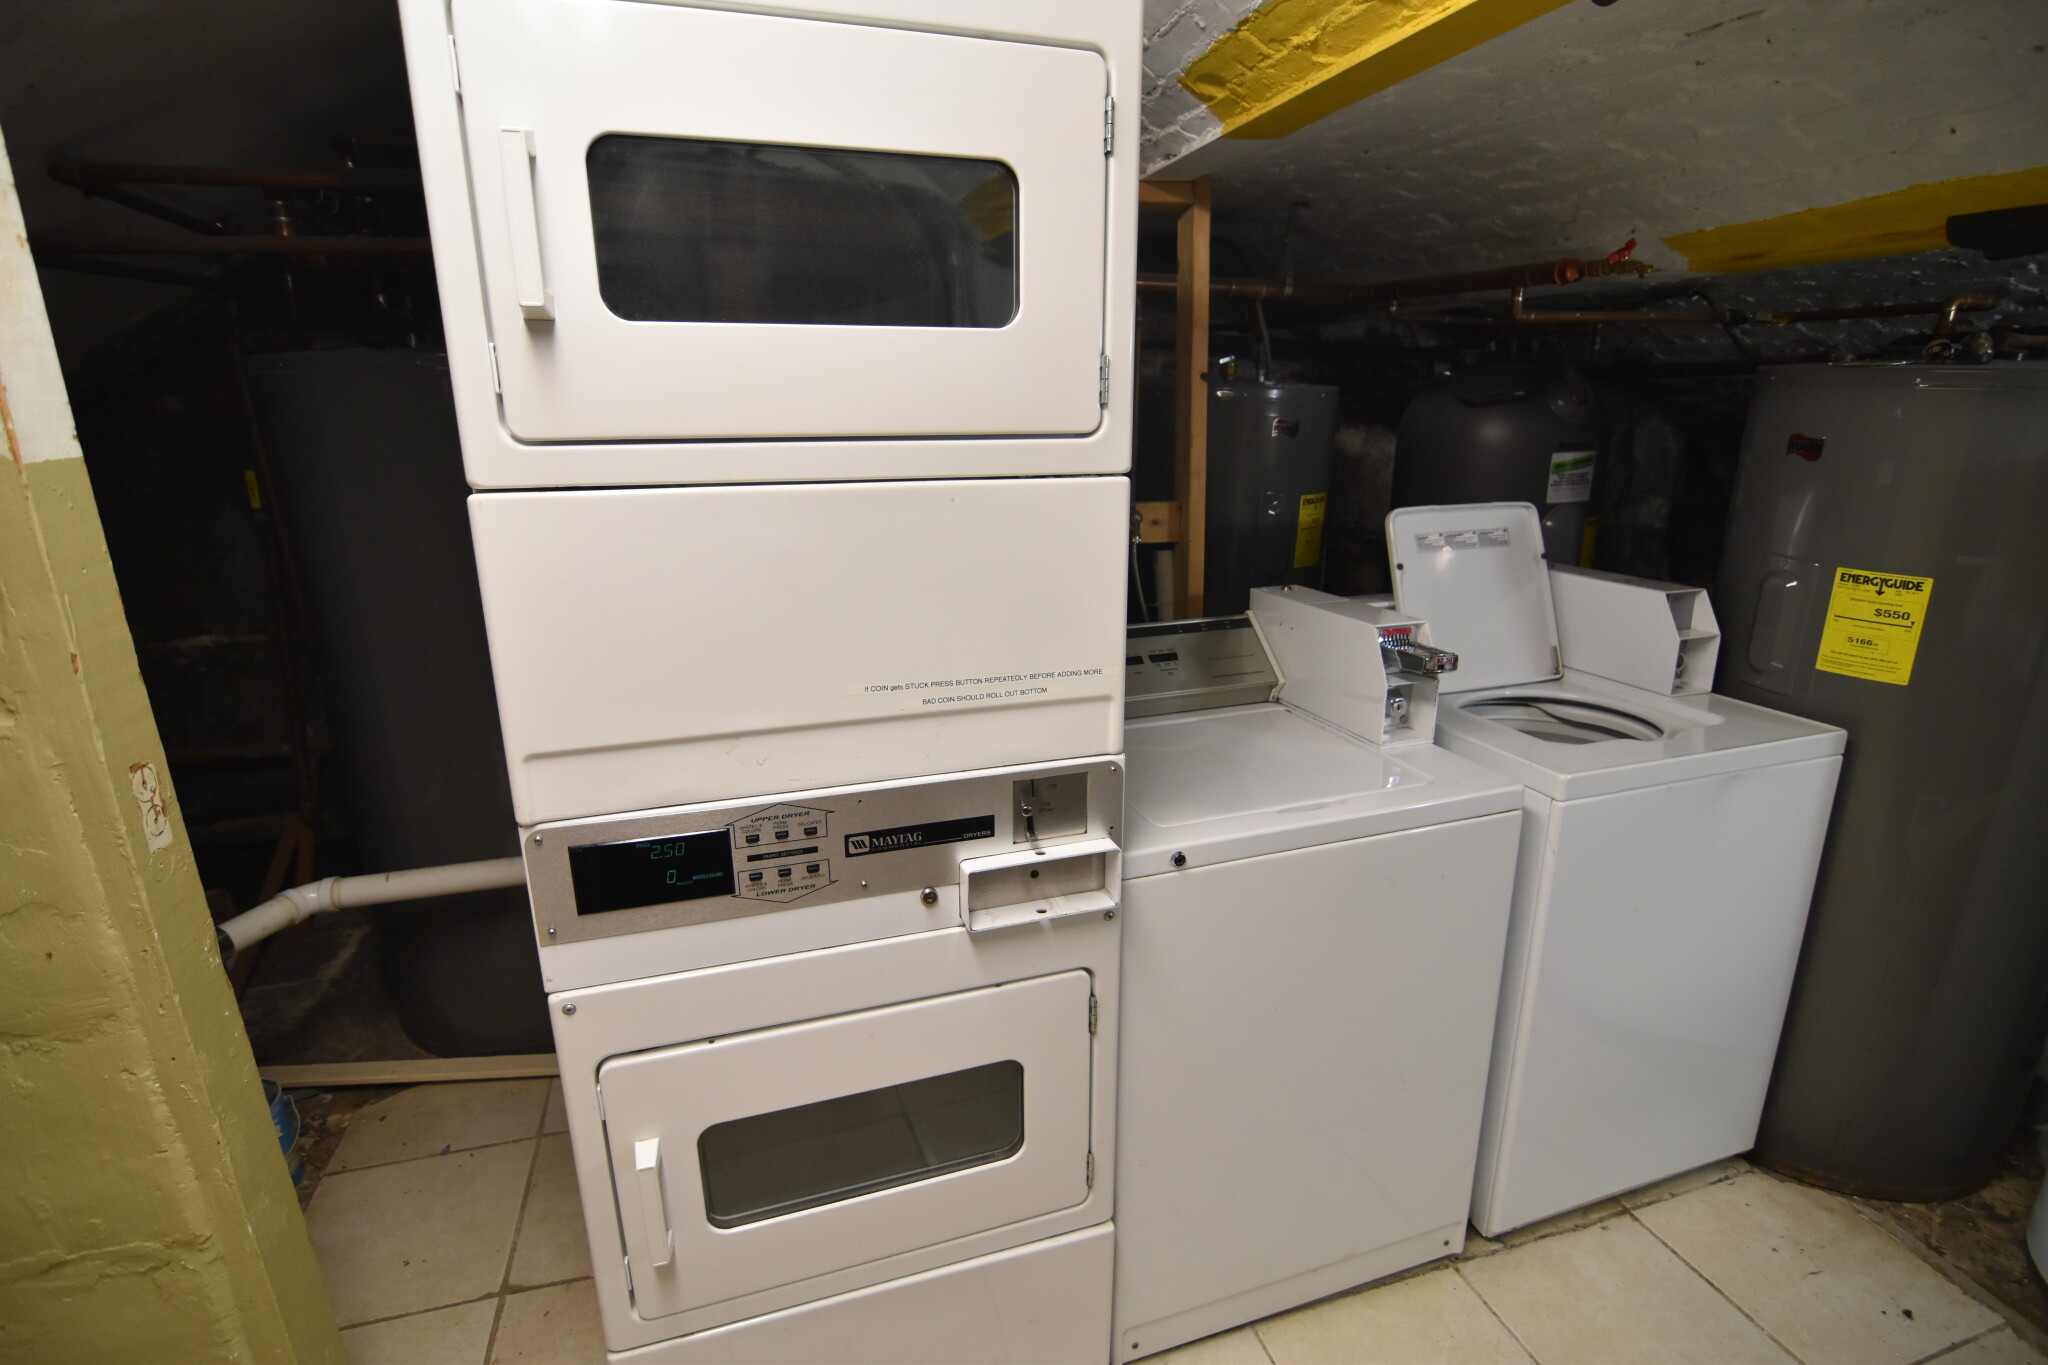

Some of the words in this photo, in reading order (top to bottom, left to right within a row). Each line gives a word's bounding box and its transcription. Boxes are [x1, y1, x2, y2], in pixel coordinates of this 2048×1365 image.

[1840, 572, 1924, 592] ENERGYGUIDE
[1873, 608, 1911, 621] $550
[1847, 636, 1873, 646] 5166
[905, 682, 929, 690] STUCK
[930, 680, 954, 688] PRESS
[955, 678, 983, 686] BUTTON
[984, 674, 1028, 683] REPEATEDLY
[1029, 672, 1056, 680] BEFORE
[1057, 670, 1082, 678] ADDING
[922, 697, 936, 705] BAD
[937, 696, 955, 704] COIN
[956, 693, 985, 702] SHOULD
[1019, 687, 1048, 696] BOTTOM
[750, 815, 780, 823] UPPER
[781, 811, 810, 820] DRYER
[871, 832, 922, 848] MAYTAG
[963, 829, 991, 839] DRYERS
[651, 842, 685, 860] 2.50
[871, 841, 922, 852] COMMERCIAL
[756, 888, 786, 897] LOWER
[788, 883, 816, 893] DRYER
